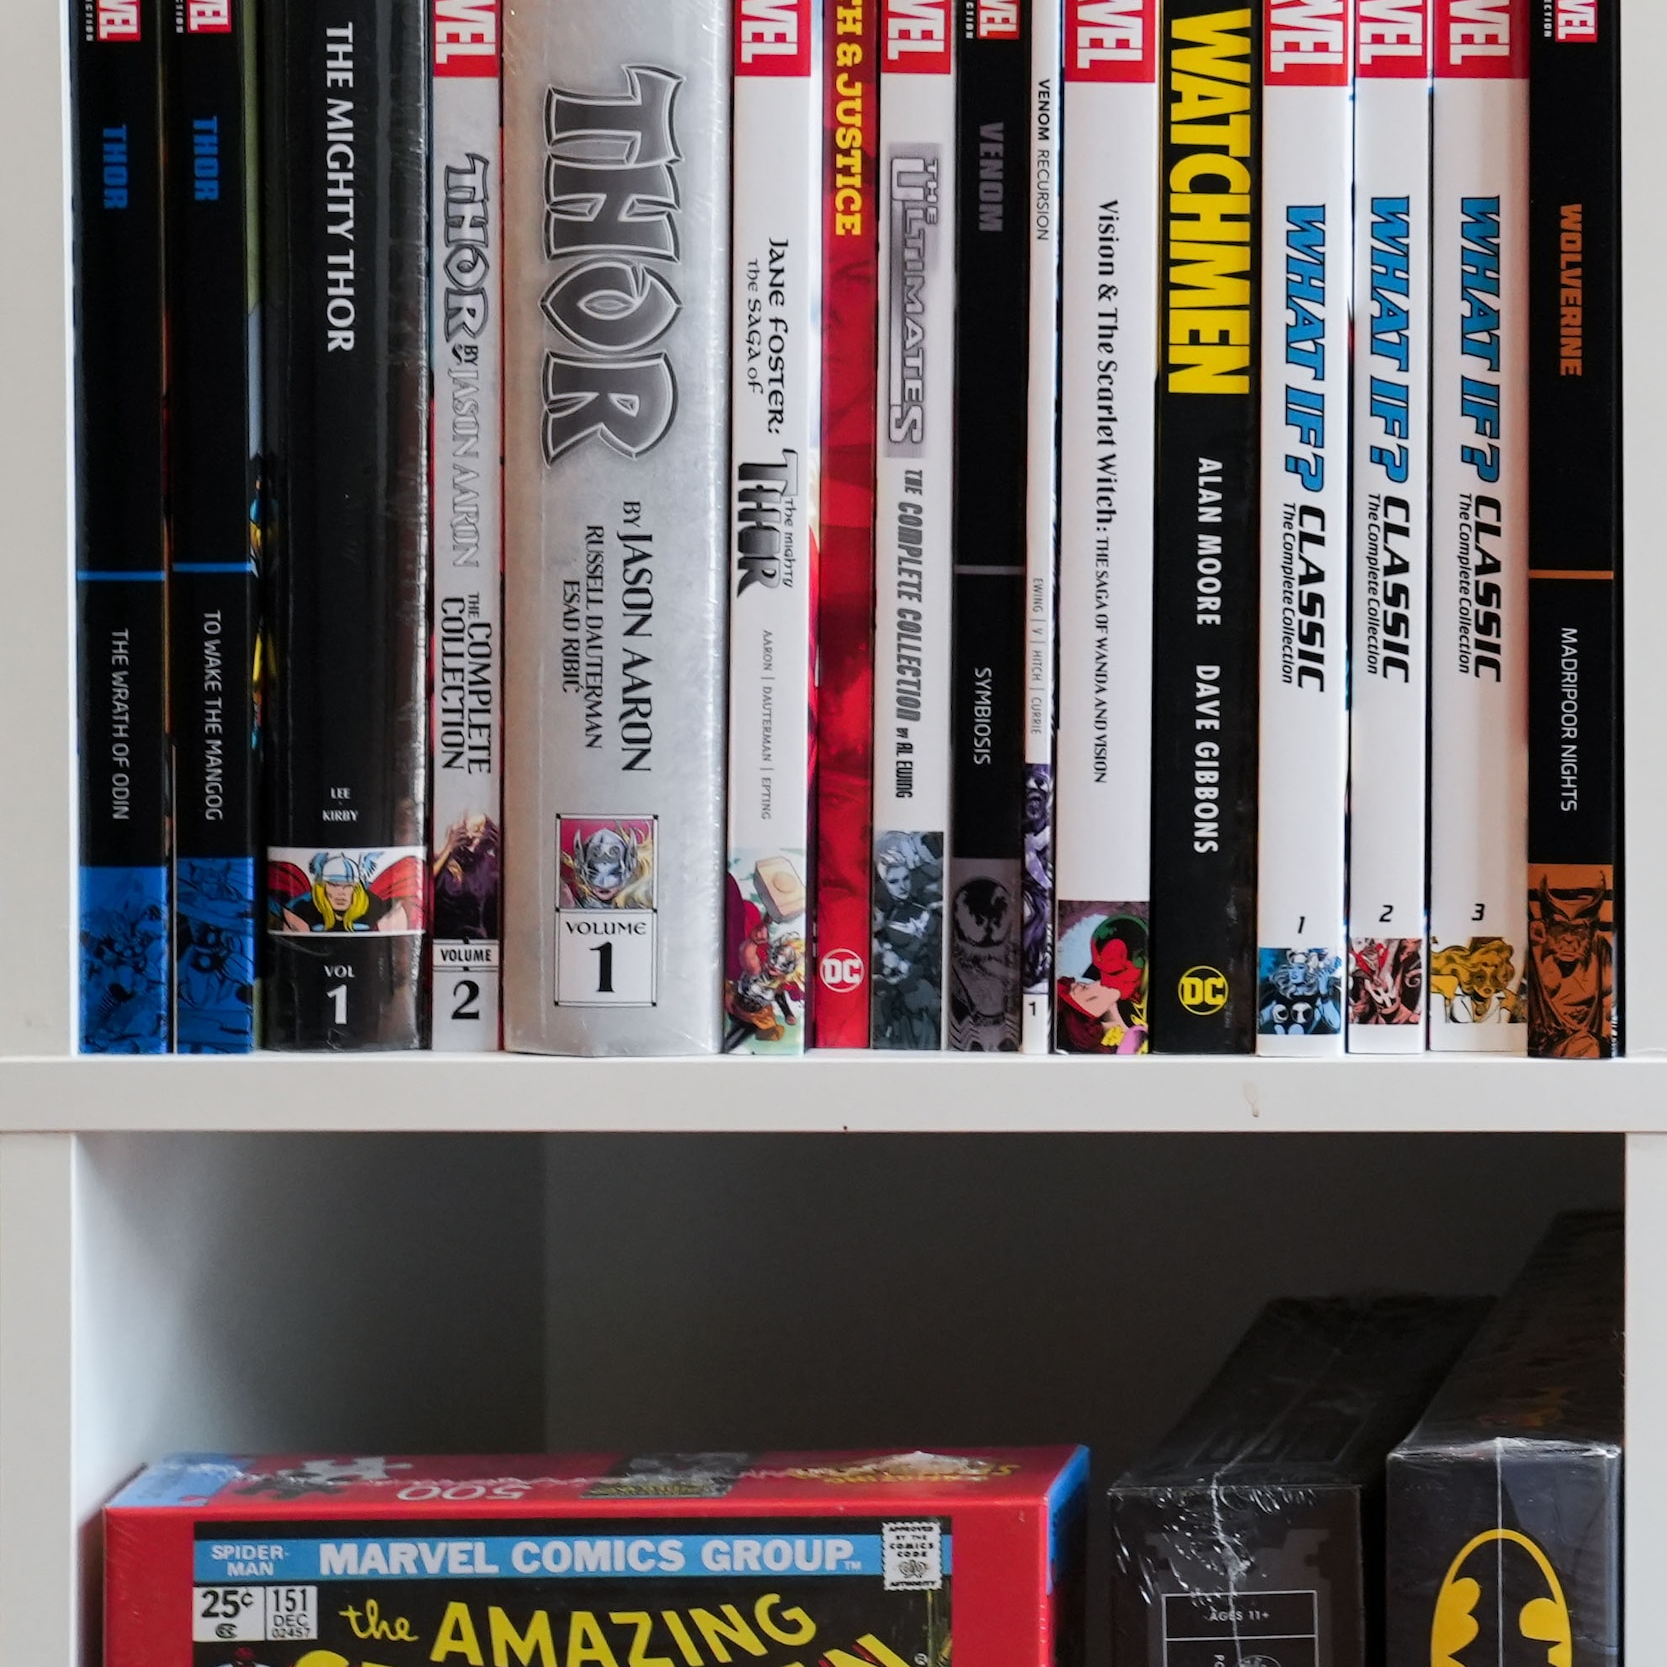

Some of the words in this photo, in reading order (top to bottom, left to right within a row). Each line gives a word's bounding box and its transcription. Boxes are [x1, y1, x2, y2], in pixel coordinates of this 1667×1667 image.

[326, 22, 353, 87] THE
[836, 42, 861, 67] &
[1038, 79, 1050, 140] VENOM
[327, 98, 354, 241] MIGHTY
[836, 73, 862, 235] JUSTICE
[1037, 150, 1049, 240] RECURSION
[1168, 8, 1251, 394] WATCHMEN
[327, 249, 355, 351] THOR
[1560, 204, 1582, 376] WOLVERINE
[1198, 458, 1222, 522] ALAN
[1197, 534, 1221, 625] MOORE
[1383, 496, 1409, 683] CLASSIC
[204, 610, 221, 634] TO
[204, 639, 222, 691] WAKE
[1196, 665, 1220, 730] DAVE
[1561, 628, 1577, 738] MADRIPOOR
[205, 697, 222, 733] THE
[974, 668, 992, 764] SYMBIOSIS
[205, 740, 223, 820] MANGOG
[1194, 742, 1219, 853] GIBBONS
[1561, 745, 1577, 811] NIGHTS
[227, 1562, 273, 1576] MAN
[320, 1542, 499, 1575] MARVEL
[512, 1539, 685, 1573] COMICS
[701, 1539, 845, 1573] GROUP
[274, 1588, 306, 1612] 151
[339, 1599, 419, 1641] the
[430, 1594, 816, 1667] AMAZING
